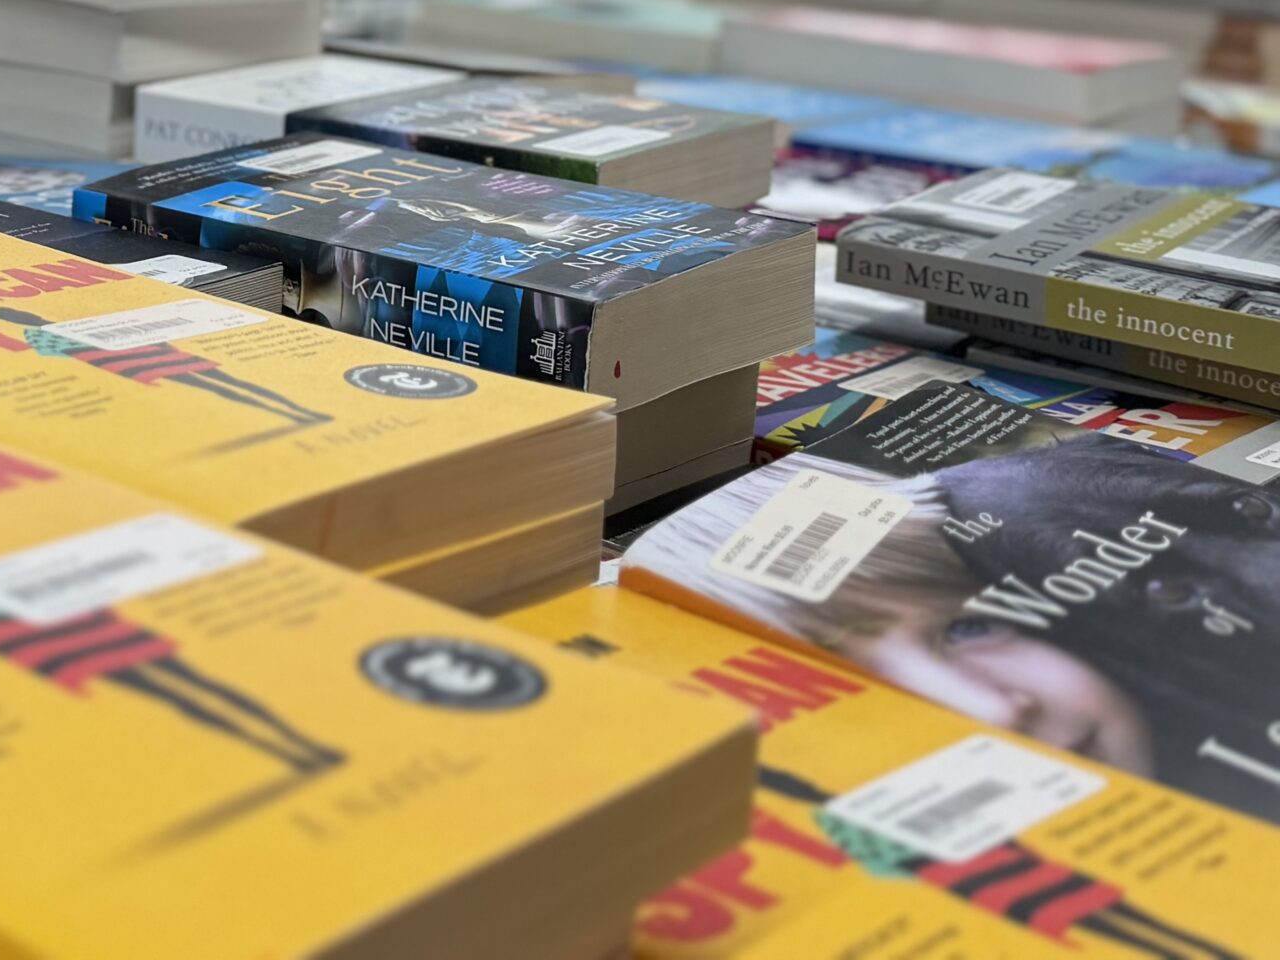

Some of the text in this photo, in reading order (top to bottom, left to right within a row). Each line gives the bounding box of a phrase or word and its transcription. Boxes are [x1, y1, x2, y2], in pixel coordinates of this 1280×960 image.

[144, 116, 180, 140] PAT
[200, 157, 464, 221] Eight
[131, 217, 155, 237] The
[487, 208, 682, 270] KATHERINE
[562, 223, 712, 271] NEVILLE
[989, 235, 1069, 267] Ian
[1052, 187, 1170, 240] McEwan
[1117, 196, 1235, 255] the innocent
[351, 274, 505, 333] KATHERINE
[846, 251, 892, 282] Ian
[904, 261, 1031, 309] McEwan
[370, 318, 480, 366] NEVILLE
[1066, 297, 1236, 351] the innocent
[554, 329, 566, 382] BALLANTINE
[563, 342, 573, 373] BOOKS
[1147, 349, 1188, 374] the
[942, 511, 1004, 545] the
[963, 509, 1189, 630] Wonder
[1201, 597, 1256, 637] of
